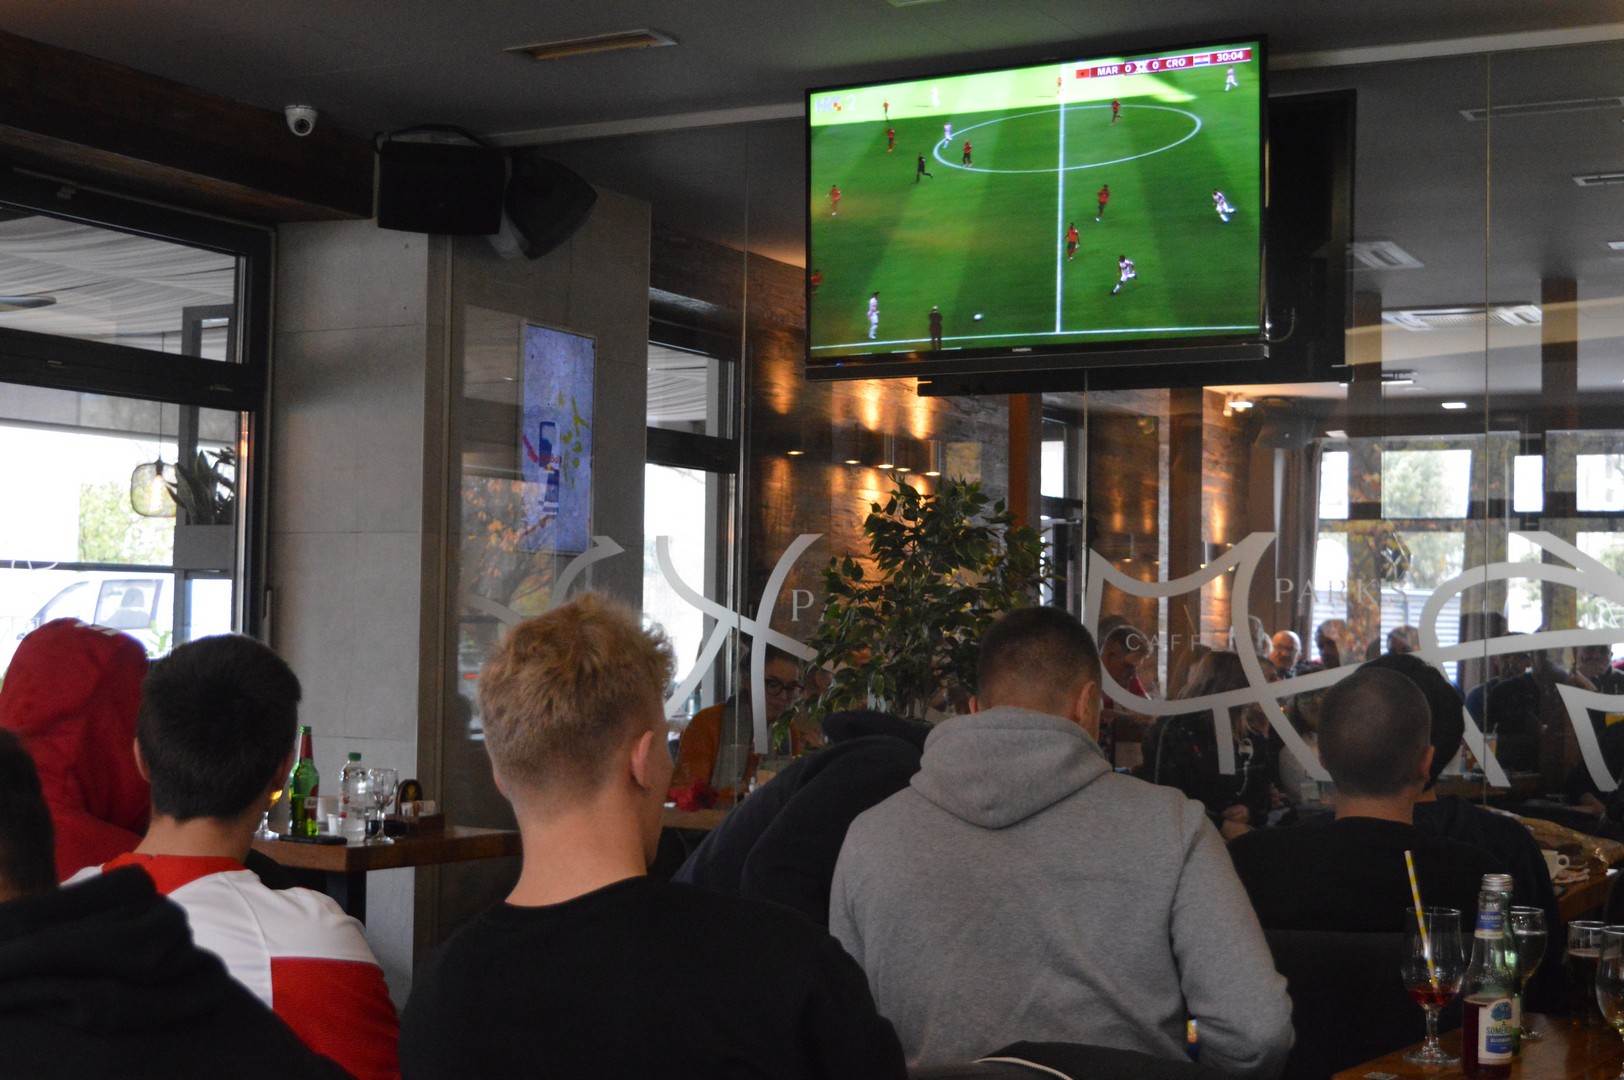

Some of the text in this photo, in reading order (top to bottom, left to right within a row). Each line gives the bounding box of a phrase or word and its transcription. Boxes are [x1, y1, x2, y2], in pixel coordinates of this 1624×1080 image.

[1097, 51, 1243, 76] MAR 0 0 CRO 30:04
[1274, 578, 1407, 603] PARKS
